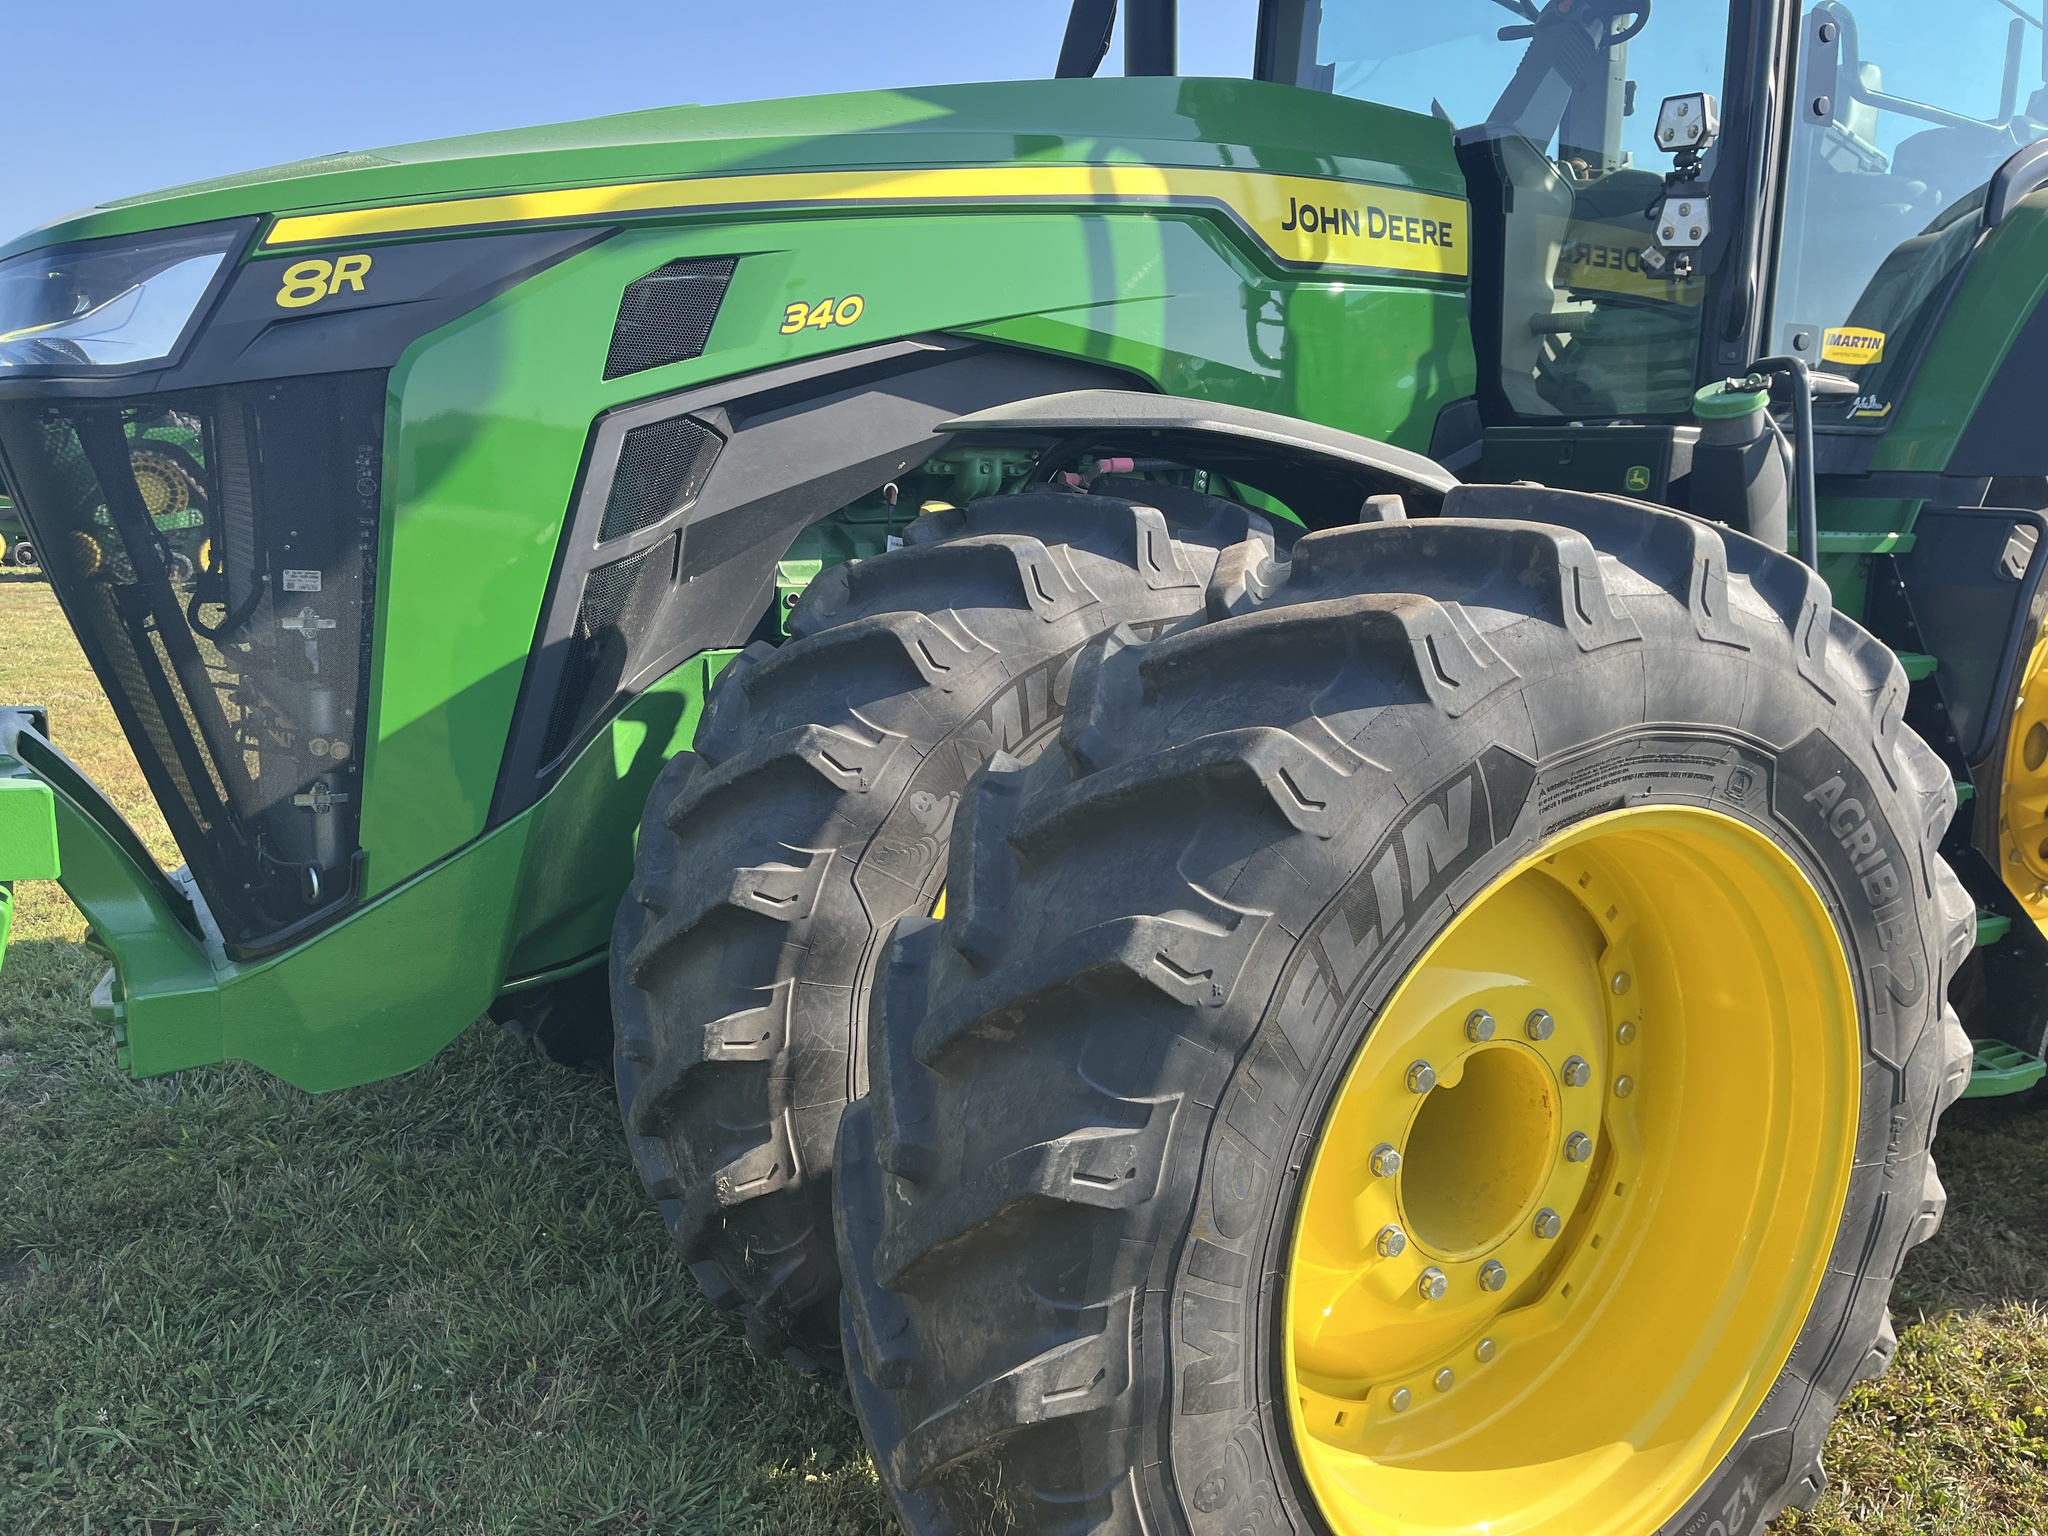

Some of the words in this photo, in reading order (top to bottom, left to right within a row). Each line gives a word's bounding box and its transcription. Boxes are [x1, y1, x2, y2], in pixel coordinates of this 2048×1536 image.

[1281, 196, 1361, 237] JOHN
[1367, 205, 1454, 249] DEERE
[275, 253, 372, 307] 8R
[778, 293, 864, 334] 340
[1826, 333, 1882, 350] MARTIN
[1803, 775, 1904, 952] AGRIBIB
[1869, 952, 1926, 1015] 2
[1182, 775, 1472, 1415] MICHELIN
